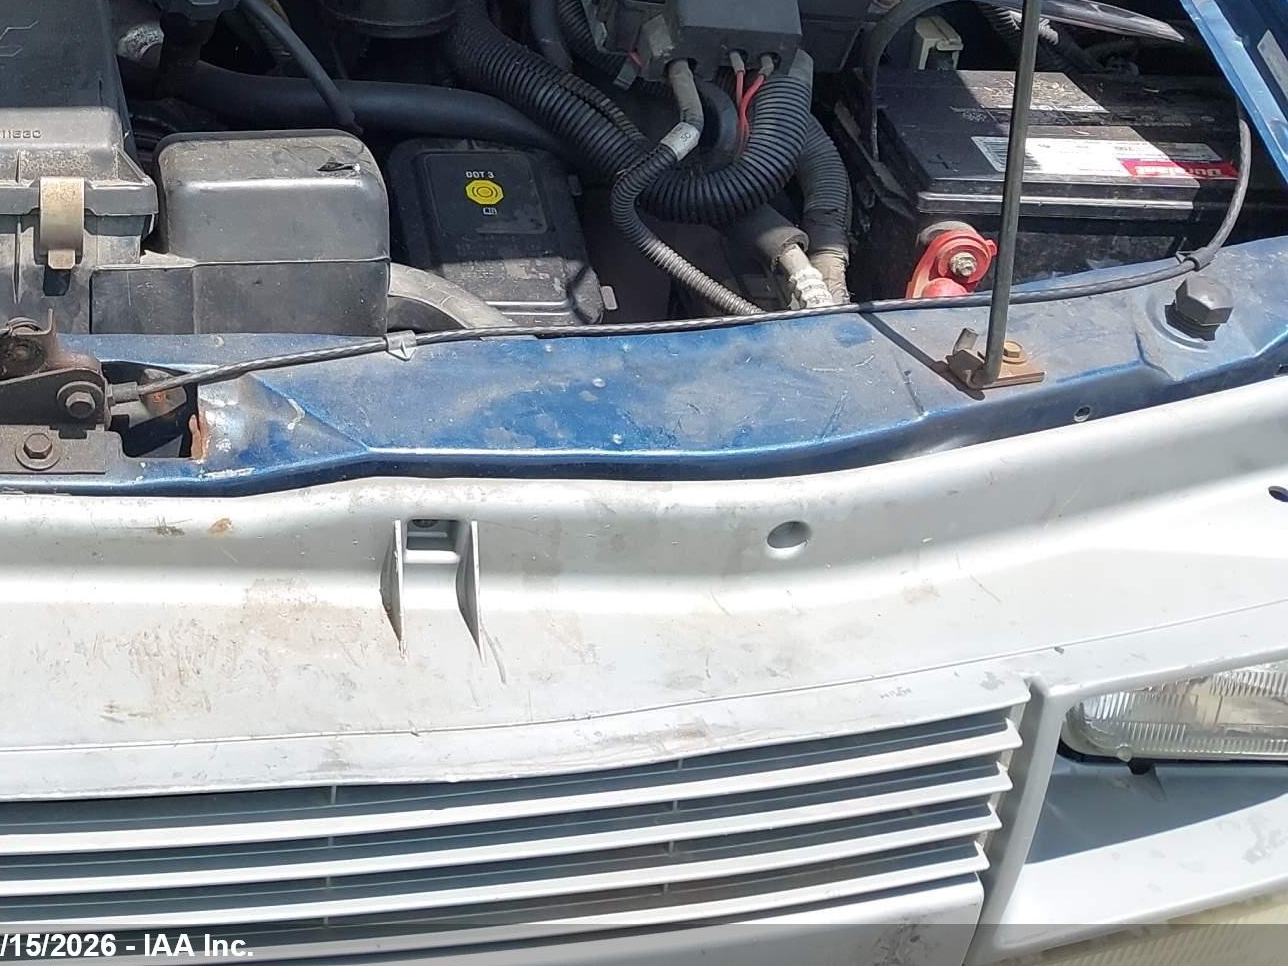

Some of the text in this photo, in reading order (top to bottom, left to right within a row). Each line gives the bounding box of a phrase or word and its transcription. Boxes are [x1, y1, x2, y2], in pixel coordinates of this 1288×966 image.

[465, 171, 495, 179] DOT 3
[1134, 165, 1222, 177] Durlast
